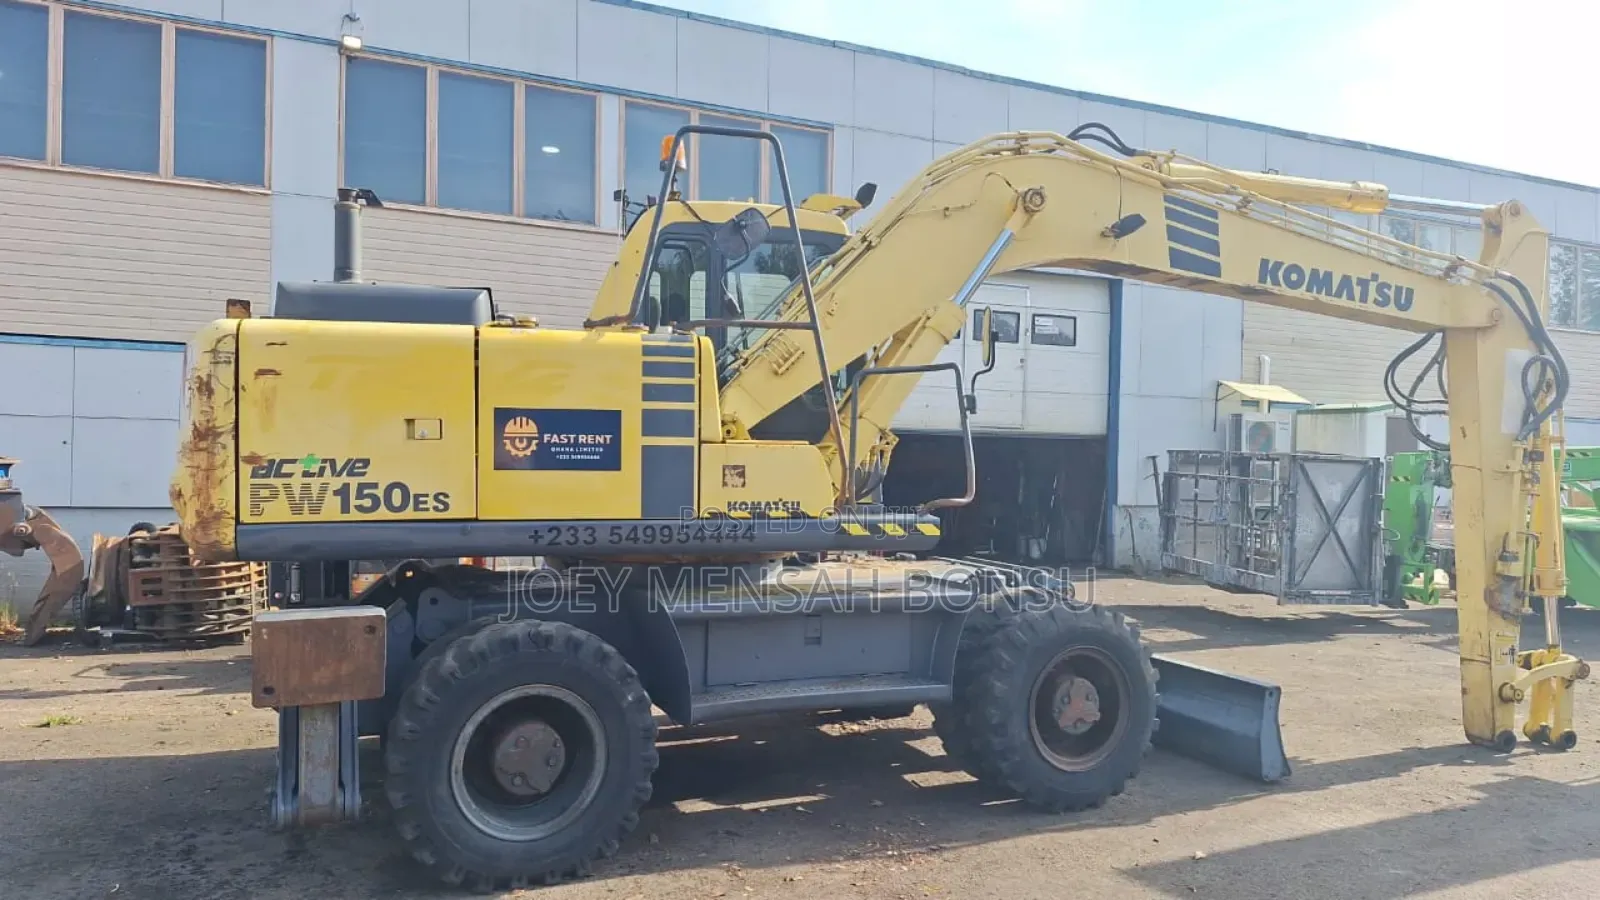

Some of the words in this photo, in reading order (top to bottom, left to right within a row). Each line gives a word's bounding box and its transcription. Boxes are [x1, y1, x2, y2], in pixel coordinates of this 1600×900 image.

[1258, 257, 1414, 312] KOMATSU
[543, 433, 577, 444] FAST
[578, 433, 613, 445] RENT
[727, 498, 801, 512] KOMATSU
[528, 525, 598, 547] +233
[607, 524, 757, 546] 549954444
